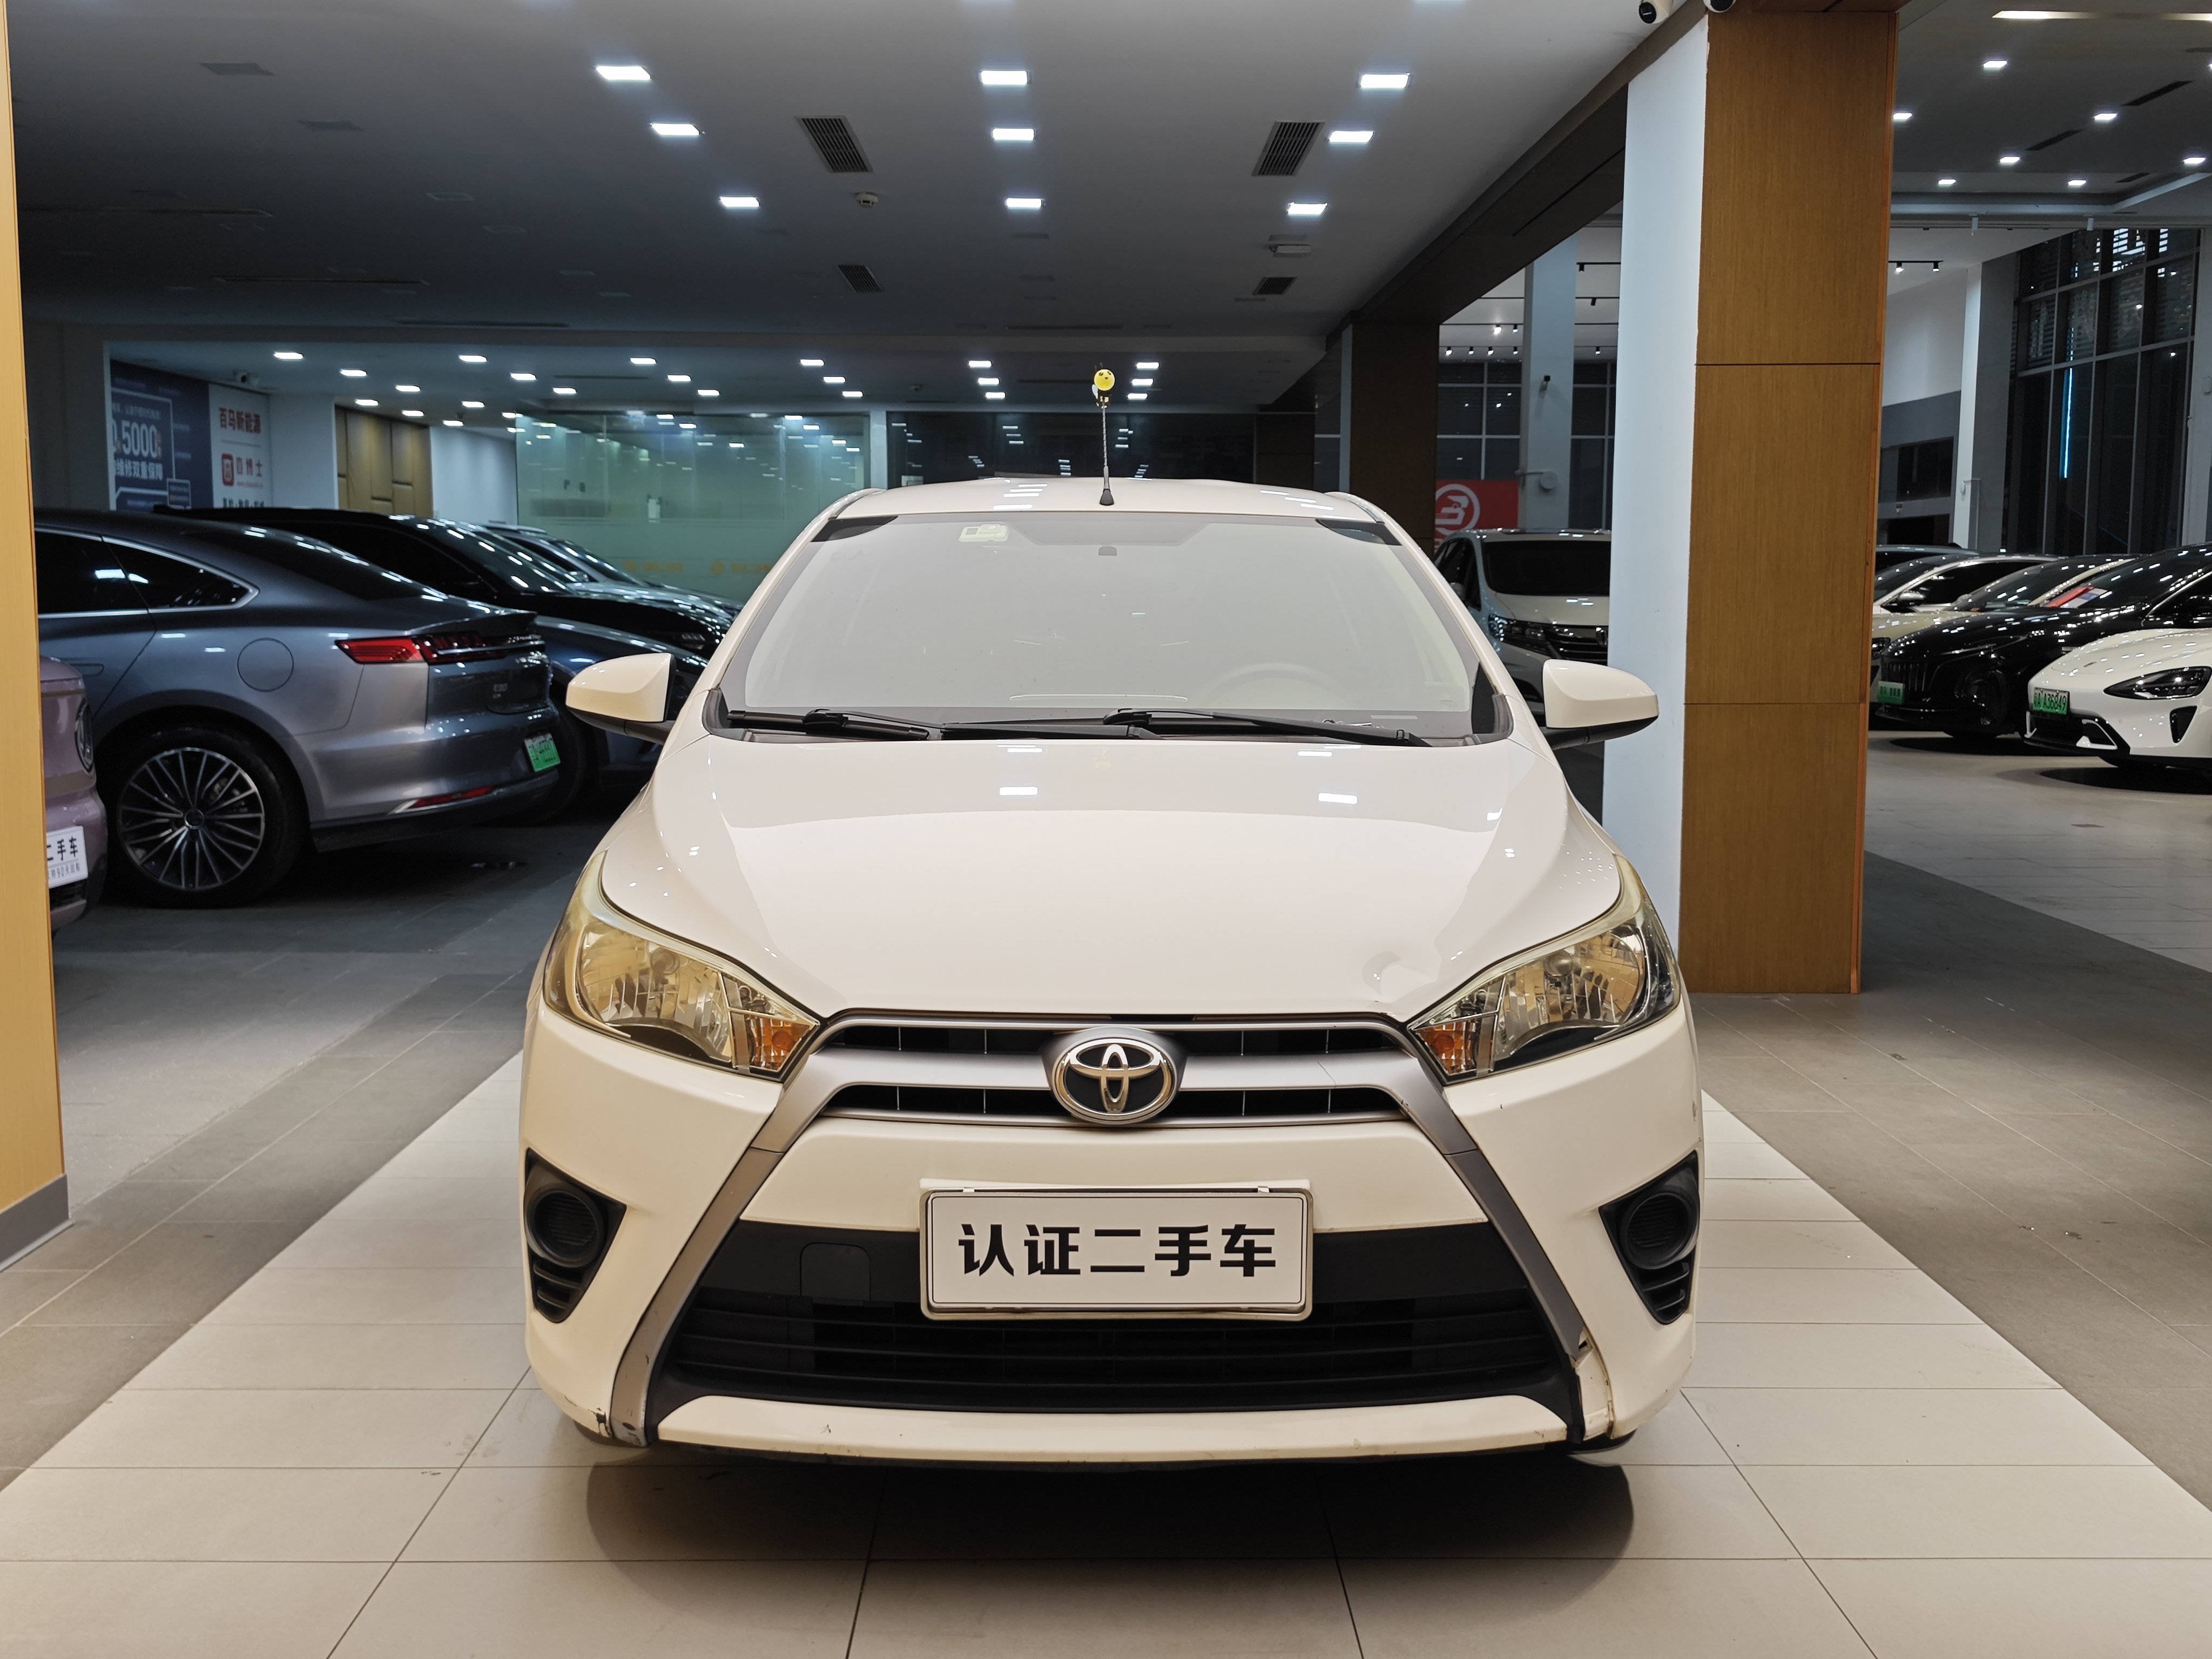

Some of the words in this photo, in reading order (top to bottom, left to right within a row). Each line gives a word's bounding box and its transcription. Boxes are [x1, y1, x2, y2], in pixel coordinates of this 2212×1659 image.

[958, 1223, 1276, 1277] 认证二手车
